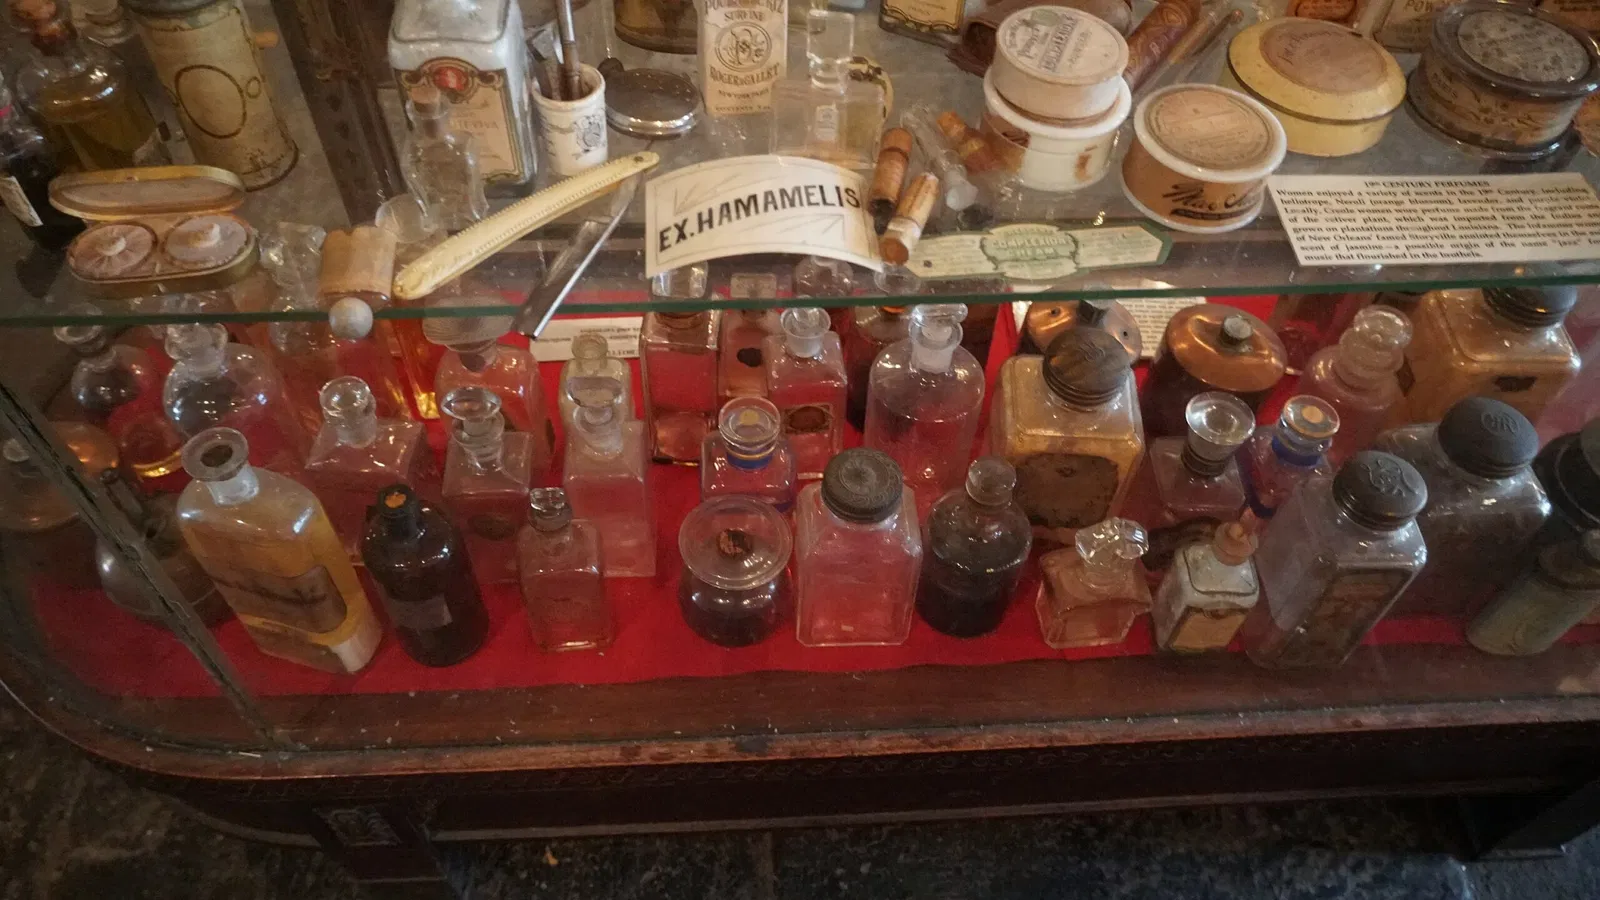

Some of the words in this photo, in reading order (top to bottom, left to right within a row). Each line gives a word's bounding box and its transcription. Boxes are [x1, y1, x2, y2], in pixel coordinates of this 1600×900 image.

[1276, 189, 1314, 197] Women
[1316, 190, 1354, 198] enjoyed
[1365, 190, 1397, 198] variety
[1541, 186, 1588, 194] including
[1453, 214, 1497, 222] imported
[1340, 225, 1394, 233] plantations
[1395, 224, 1450, 232] throughout
[1408, 232, 1456, 240] Storyville
[1458, 231, 1500, 239] anointed
[1404, 243, 1444, 251] possible
[1449, 242, 1480, 250] origin
[1304, 253, 1332, 261] music
[1335, 252, 1355, 260] that
[1355, 252, 1408, 260] flourished
